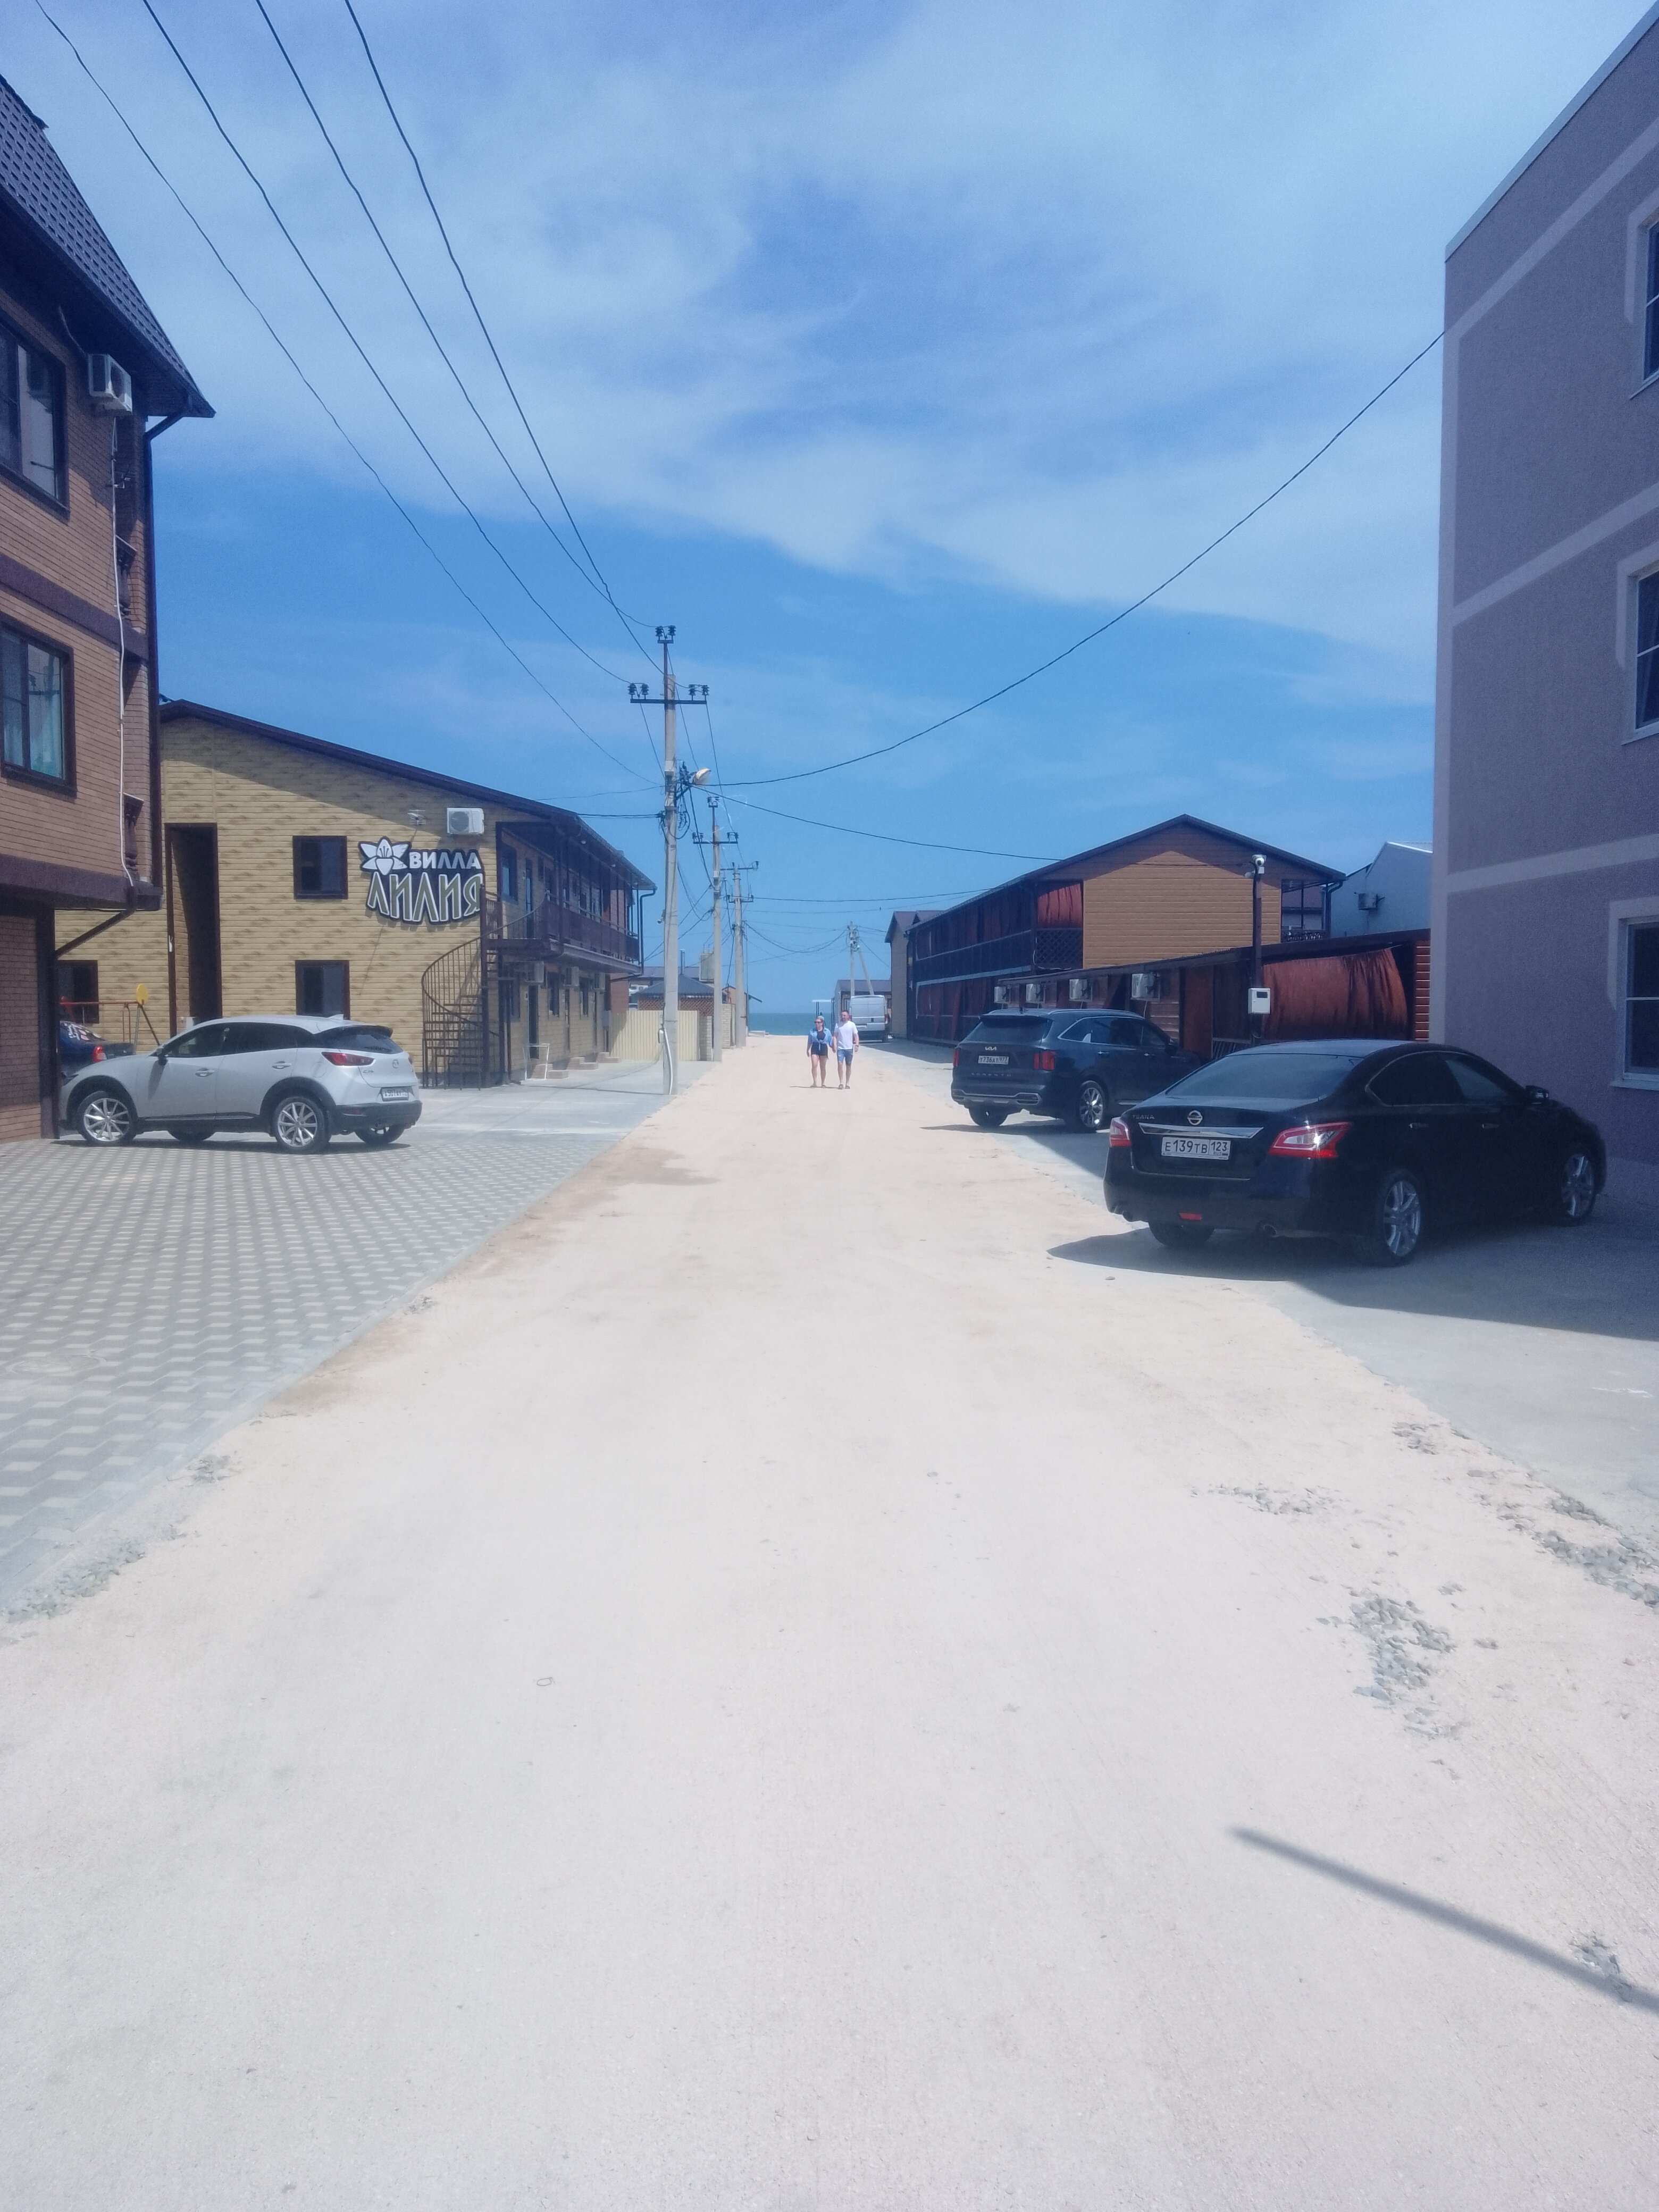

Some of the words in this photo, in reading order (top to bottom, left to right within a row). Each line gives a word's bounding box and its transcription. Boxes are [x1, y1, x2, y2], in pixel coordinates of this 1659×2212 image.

[409, 852, 481, 869] ВИЛЛА
[367, 871, 483, 922] ЛИЛИЯ
[1210, 1141, 1228, 1152] 123
